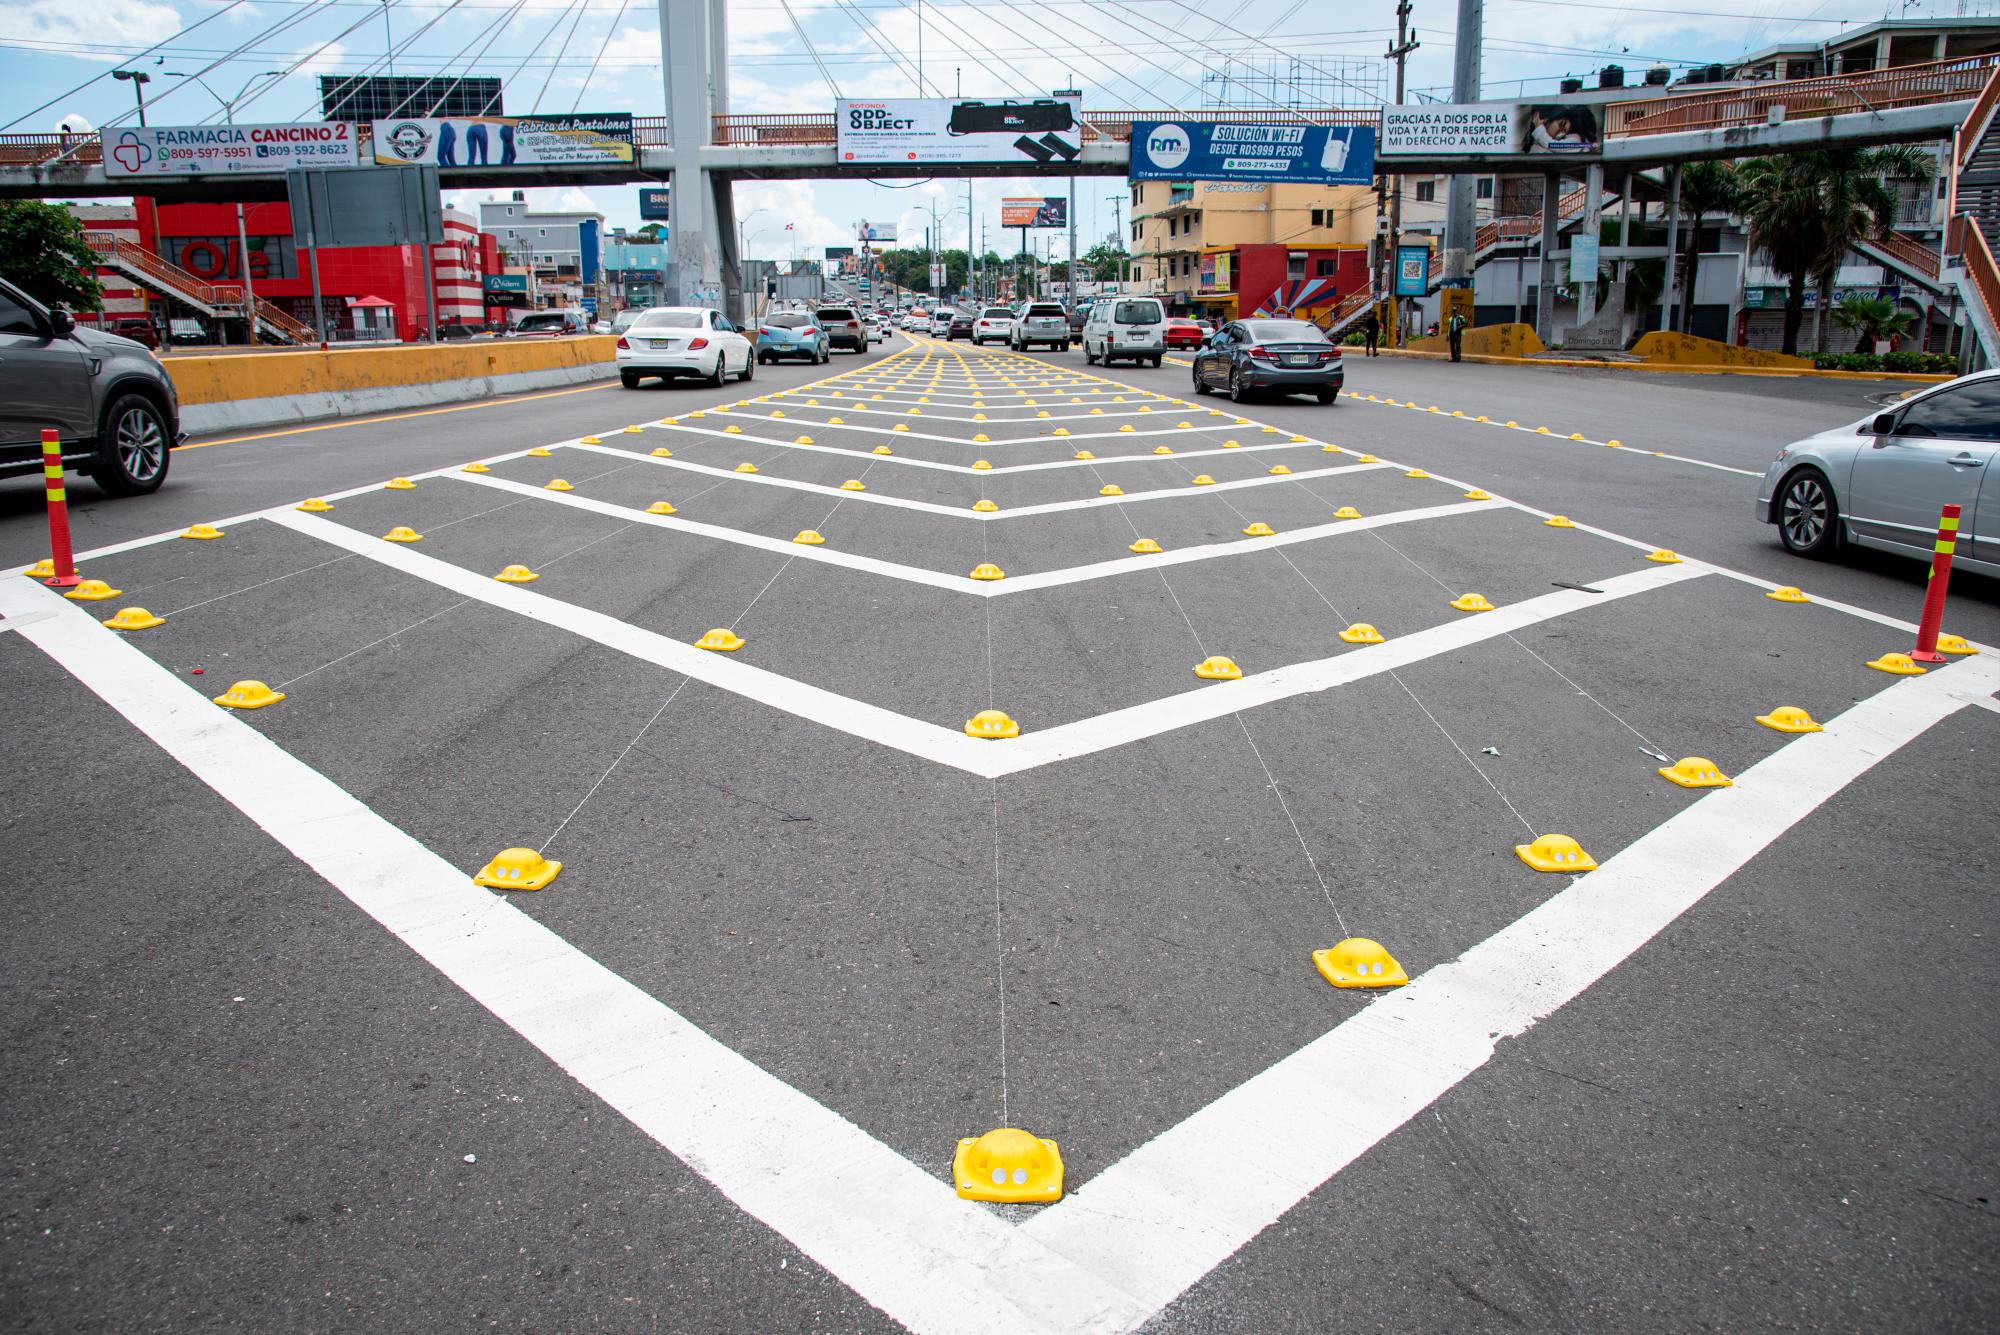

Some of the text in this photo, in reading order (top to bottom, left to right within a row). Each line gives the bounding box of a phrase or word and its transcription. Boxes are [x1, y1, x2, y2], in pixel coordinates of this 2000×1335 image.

[1387, 113, 1508, 124] GRACIAS A DIOS POR LA
[516, 117, 630, 133] Fabrica de Pantalones
[1388, 125, 1507, 135] VIDA Y A TI POR RESPETAR
[156, 123, 348, 145] FARMACIA CANCINO 2
[582, 133, 631, 144] 829-406-6833
[1217, 126, 1300, 142] SOLUCIÓN WI-FI
[1388, 136, 1506, 146] MI DERECHO A NACER
[171, 144, 348, 159] 809-597-5951 809-592-8623
[1209, 143, 1304, 157] DESDE RD$999 PESOS
[1236, 160, 1287, 169] 809-273-4333
[1568, 337, 1600, 346] Domingo
